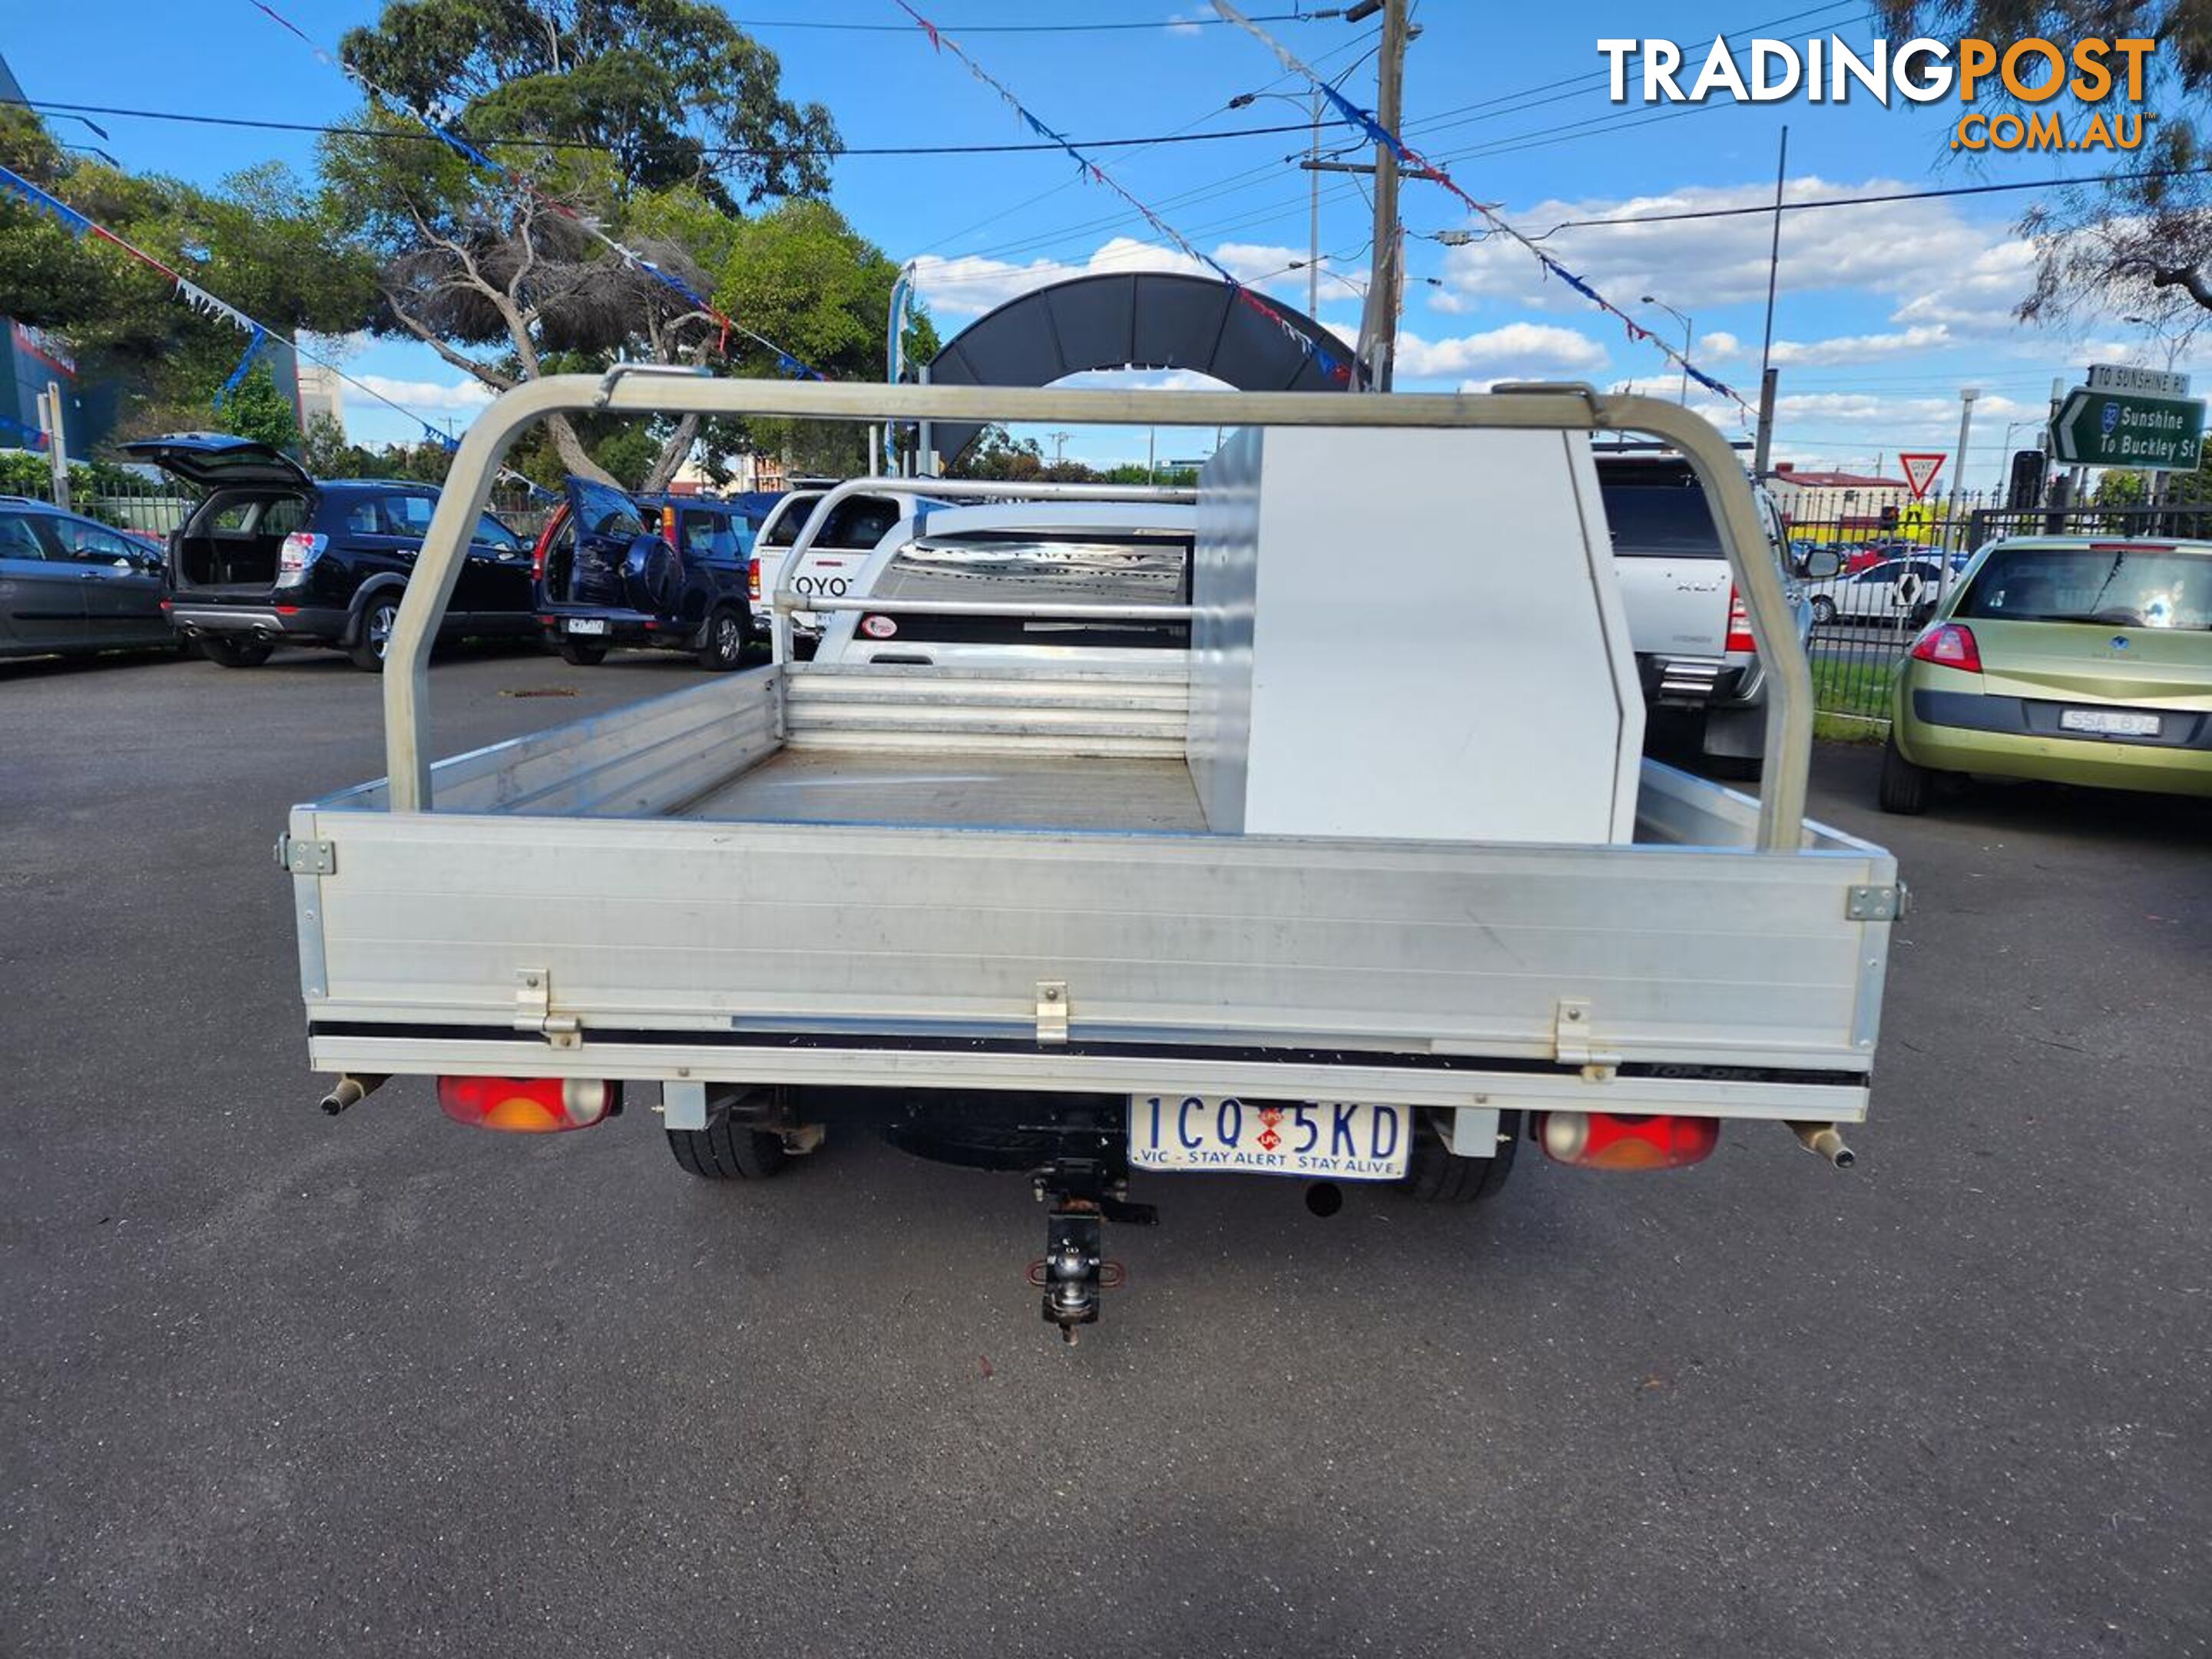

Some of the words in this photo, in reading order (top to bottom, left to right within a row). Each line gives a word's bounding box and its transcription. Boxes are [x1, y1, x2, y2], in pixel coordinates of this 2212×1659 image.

[2099, 368, 2110, 386] TO
[2116, 369, 2169, 392] SUNSHINE
[2174, 376, 2186, 393] RD
[2122, 407, 2184, 429] Sunshine
[2101, 434, 2114, 454] To
[2121, 435, 2176, 461] Buckley
[2181, 439, 2196, 458] St
[792, 576, 854, 597] OYO
[1141, 1151, 1168, 1164] VIC
[1188, 1151, 1230, 1164] STAY
[1235, 1153, 1287, 1167] ALERT
[1298, 1155, 1339, 1171] STAY
[1345, 1160, 1394, 1174] ALIVE
